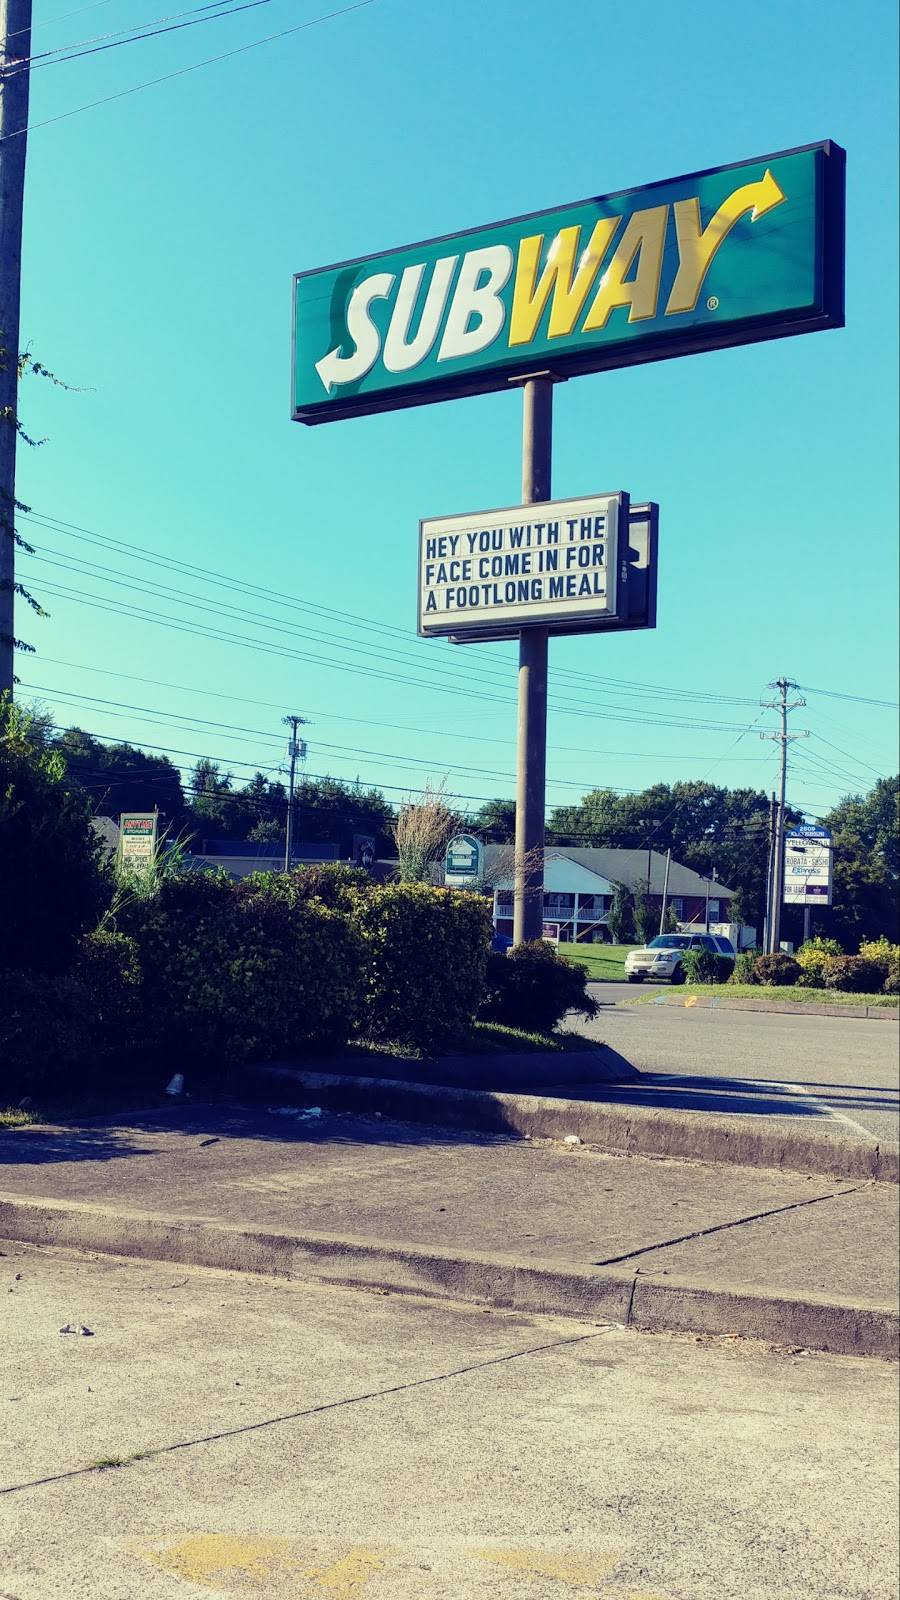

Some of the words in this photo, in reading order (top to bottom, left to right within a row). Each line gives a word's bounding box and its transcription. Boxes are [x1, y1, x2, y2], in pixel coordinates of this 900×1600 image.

[315, 169, 788, 394] SUBWAY
[426, 535, 460, 559] HEY
[467, 529, 503, 553] YOU
[509, 521, 559, 548] WITH
[566, 516, 605, 541] THE
[426, 559, 471, 586] FACE
[479, 552, 532, 579] COME
[539, 548, 558, 572] IN
[566, 543, 604, 569] FOR
[426, 590, 437, 611] A
[446, 578, 542, 609] FOOTLONG
[549, 572, 605, 598] MEAL
